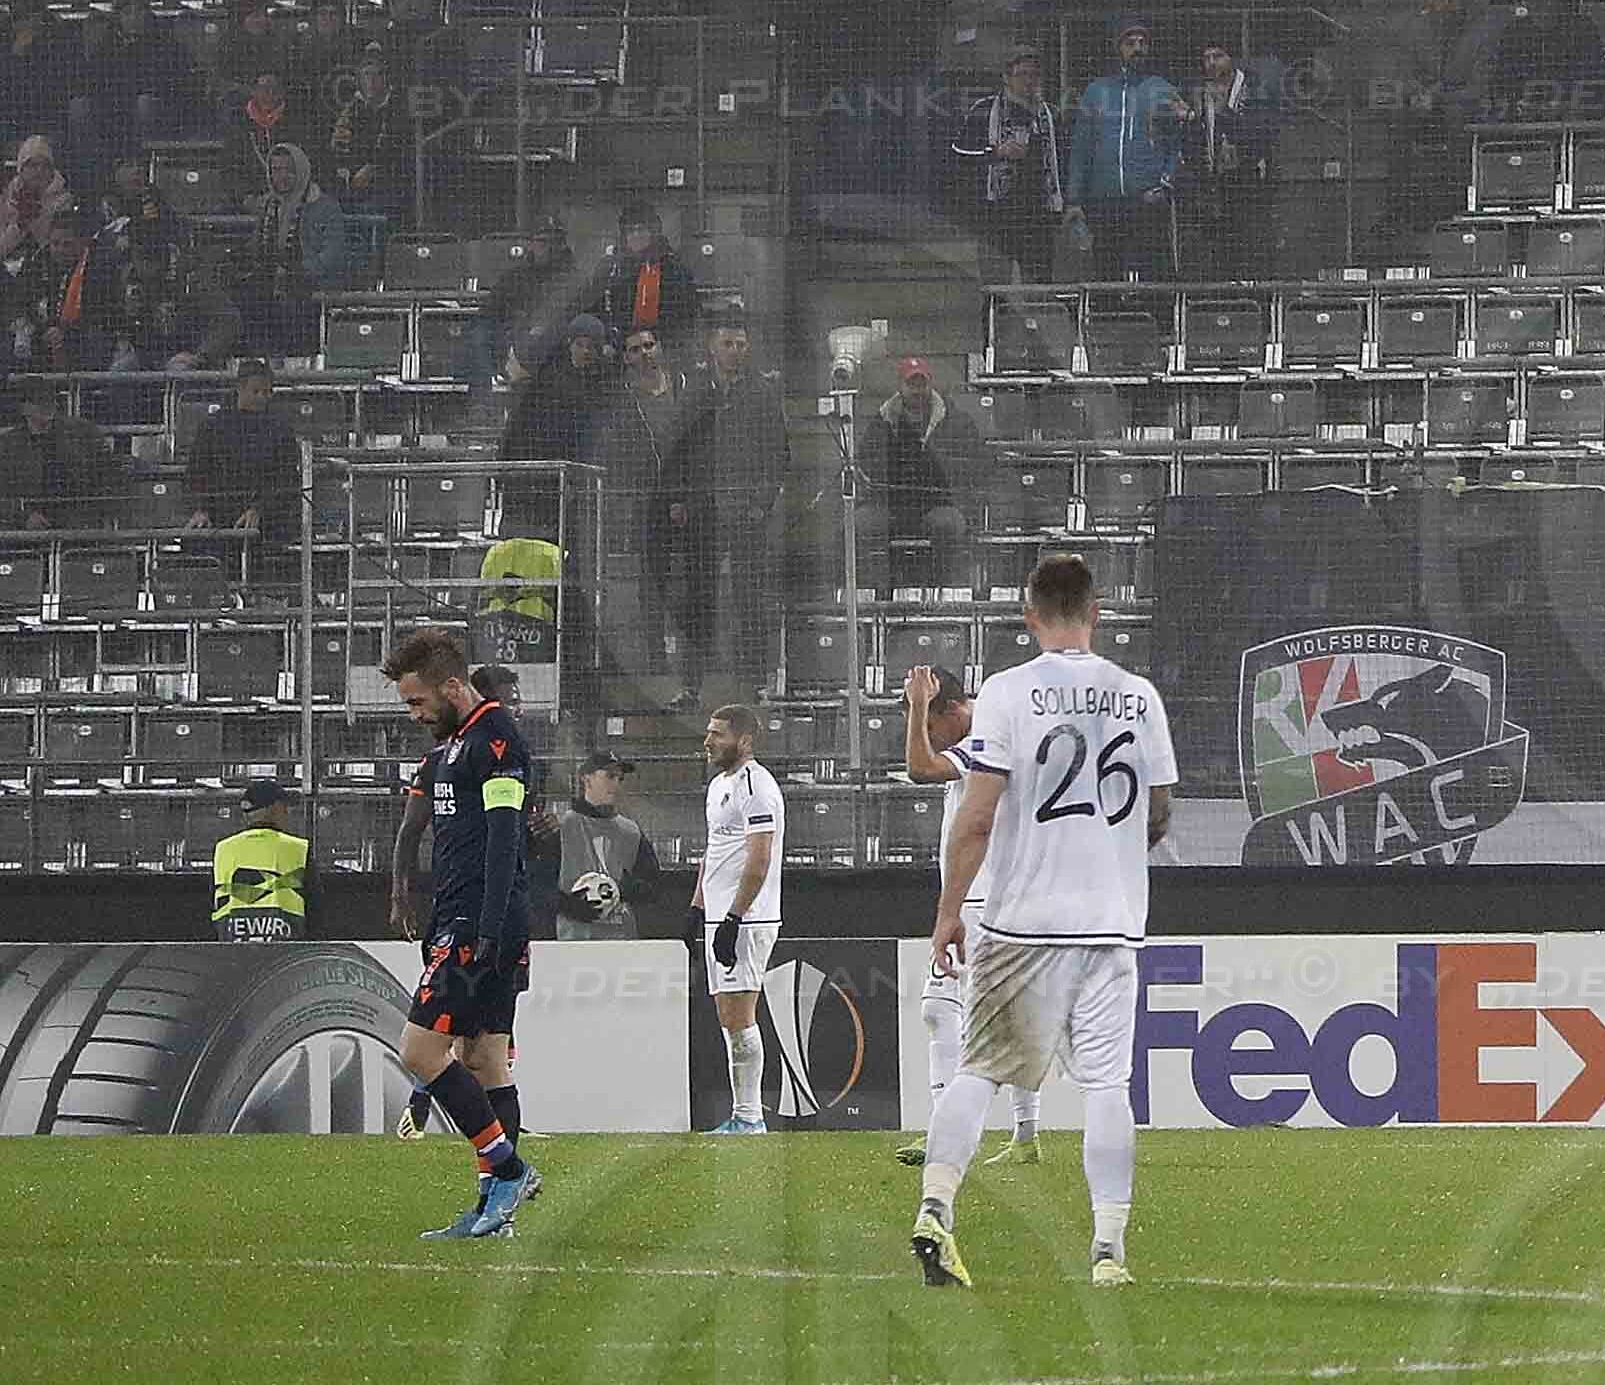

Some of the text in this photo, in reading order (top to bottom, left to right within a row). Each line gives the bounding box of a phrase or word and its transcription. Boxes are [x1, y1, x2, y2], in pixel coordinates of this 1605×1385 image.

[1284, 632, 1465, 662] WOLFSBERGER AC
[1031, 686, 1149, 723] SOLLBAUER
[1035, 723, 1139, 827] 26
[1286, 768, 1477, 866] WAC
